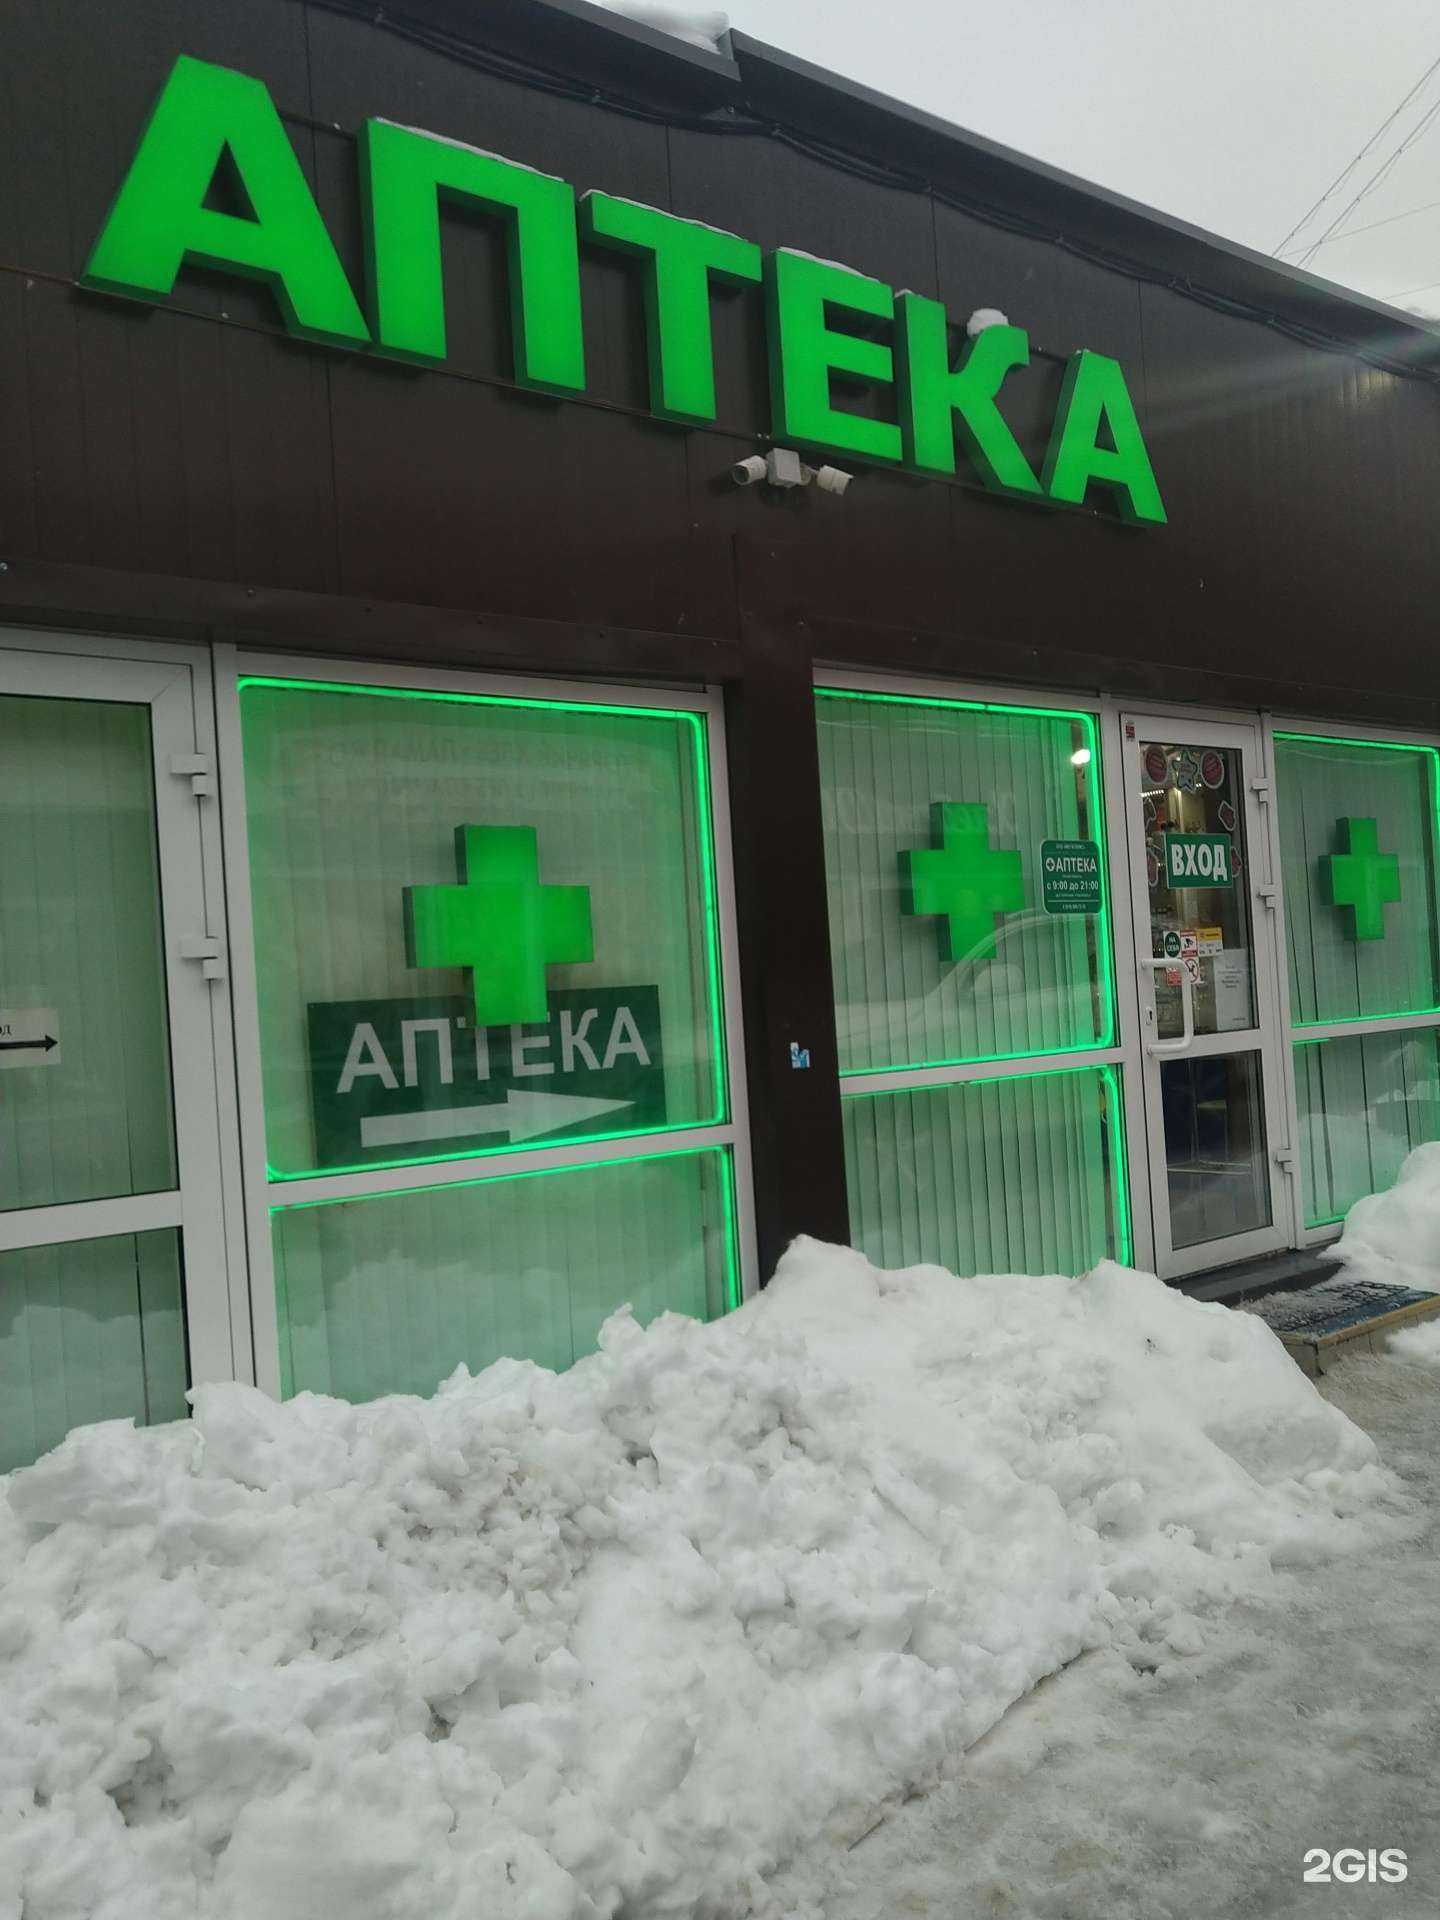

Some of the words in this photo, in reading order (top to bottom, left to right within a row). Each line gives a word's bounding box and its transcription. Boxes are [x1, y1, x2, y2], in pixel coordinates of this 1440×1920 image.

[82, 55, 1168, 523] АПТЕКА
[1056, 857, 1097, 873] АПТЕКА
[1171, 843, 1228, 881] ВХОД
[1069, 882, 1079, 891] до
[1080, 880, 1099, 890] 21:00
[336, 1006, 651, 1094] АПТЕКА
